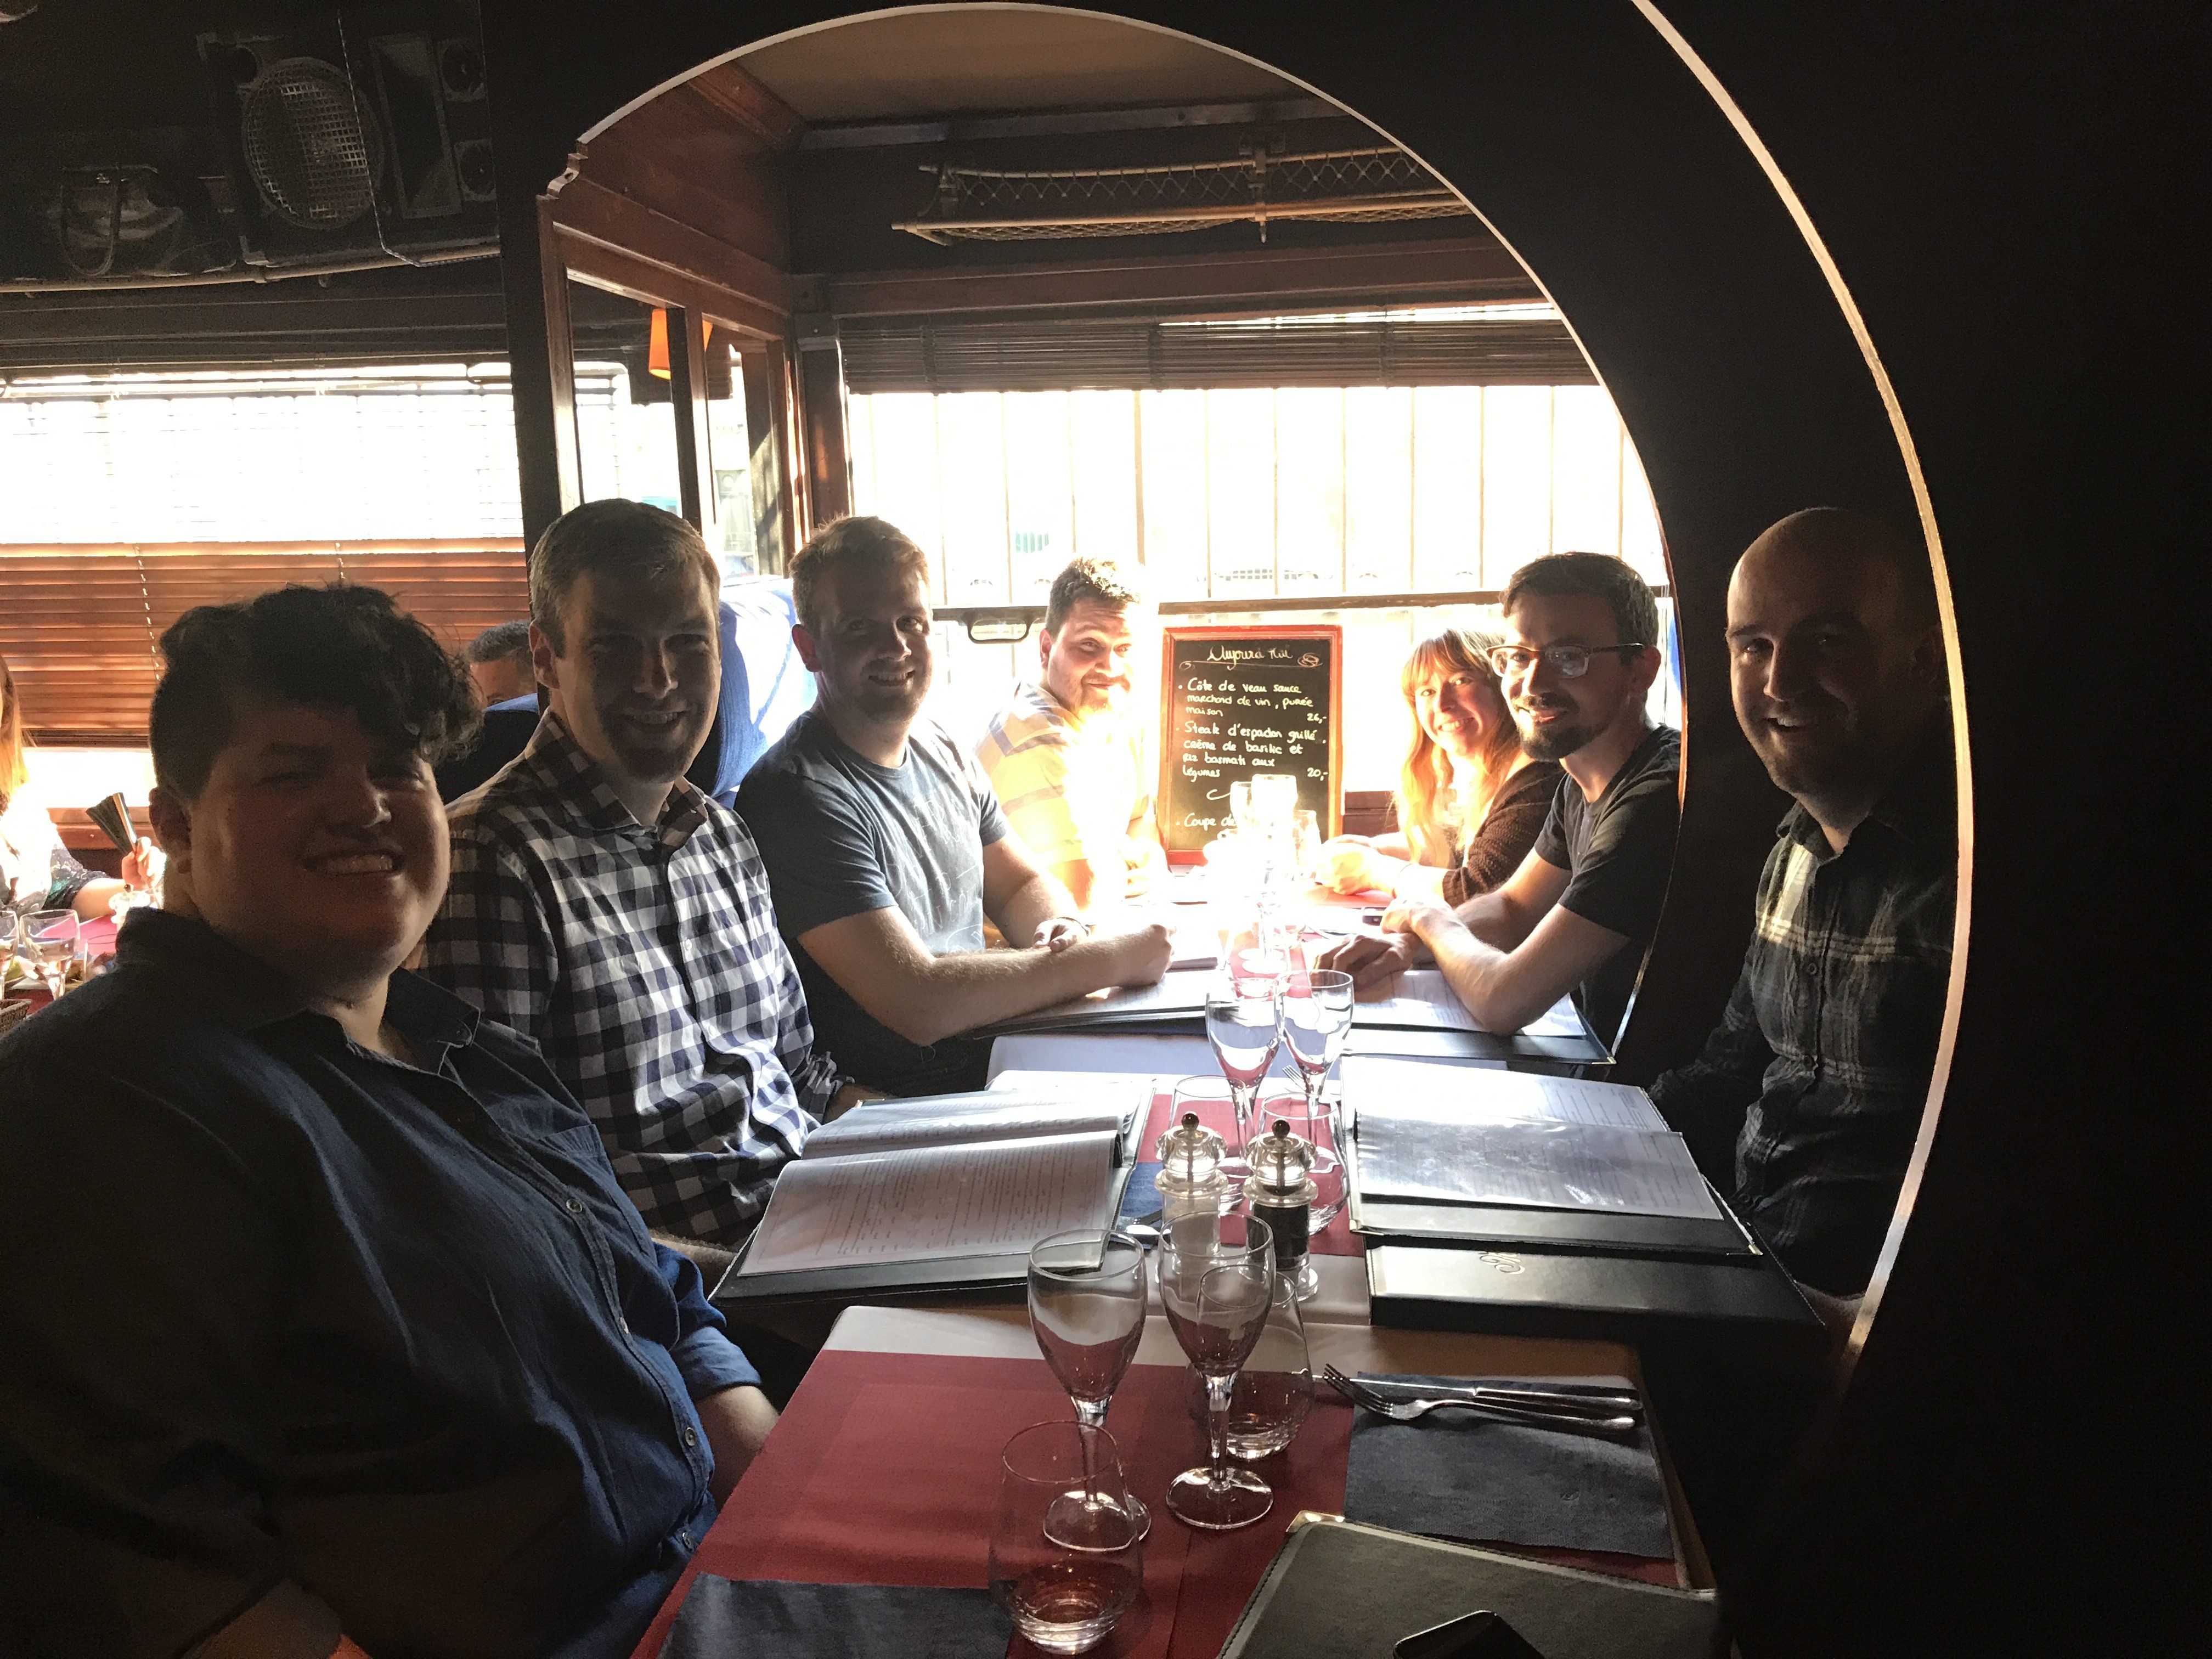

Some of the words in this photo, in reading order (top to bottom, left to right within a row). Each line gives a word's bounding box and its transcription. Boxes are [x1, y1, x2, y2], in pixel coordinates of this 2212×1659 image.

[1218, 680, 1236, 691] de
[1243, 684, 1267, 692] veau
[1273, 684, 1302, 693] sauce
[1237, 696, 1251, 706] de
[1283, 697, 1313, 710] purée
[1186, 707, 1223, 716] maison
[1184, 721, 1220, 735] Steak
[1222, 741, 1237, 752] de
[1245, 740, 1283, 754] basilic
[1289, 744, 1304, 754] et
[1204, 752, 1246, 765] basmati
[1252, 758, 1276, 767] aux
[1182, 765, 1220, 782] légumes
[1183, 812, 1217, 831] Coupe
